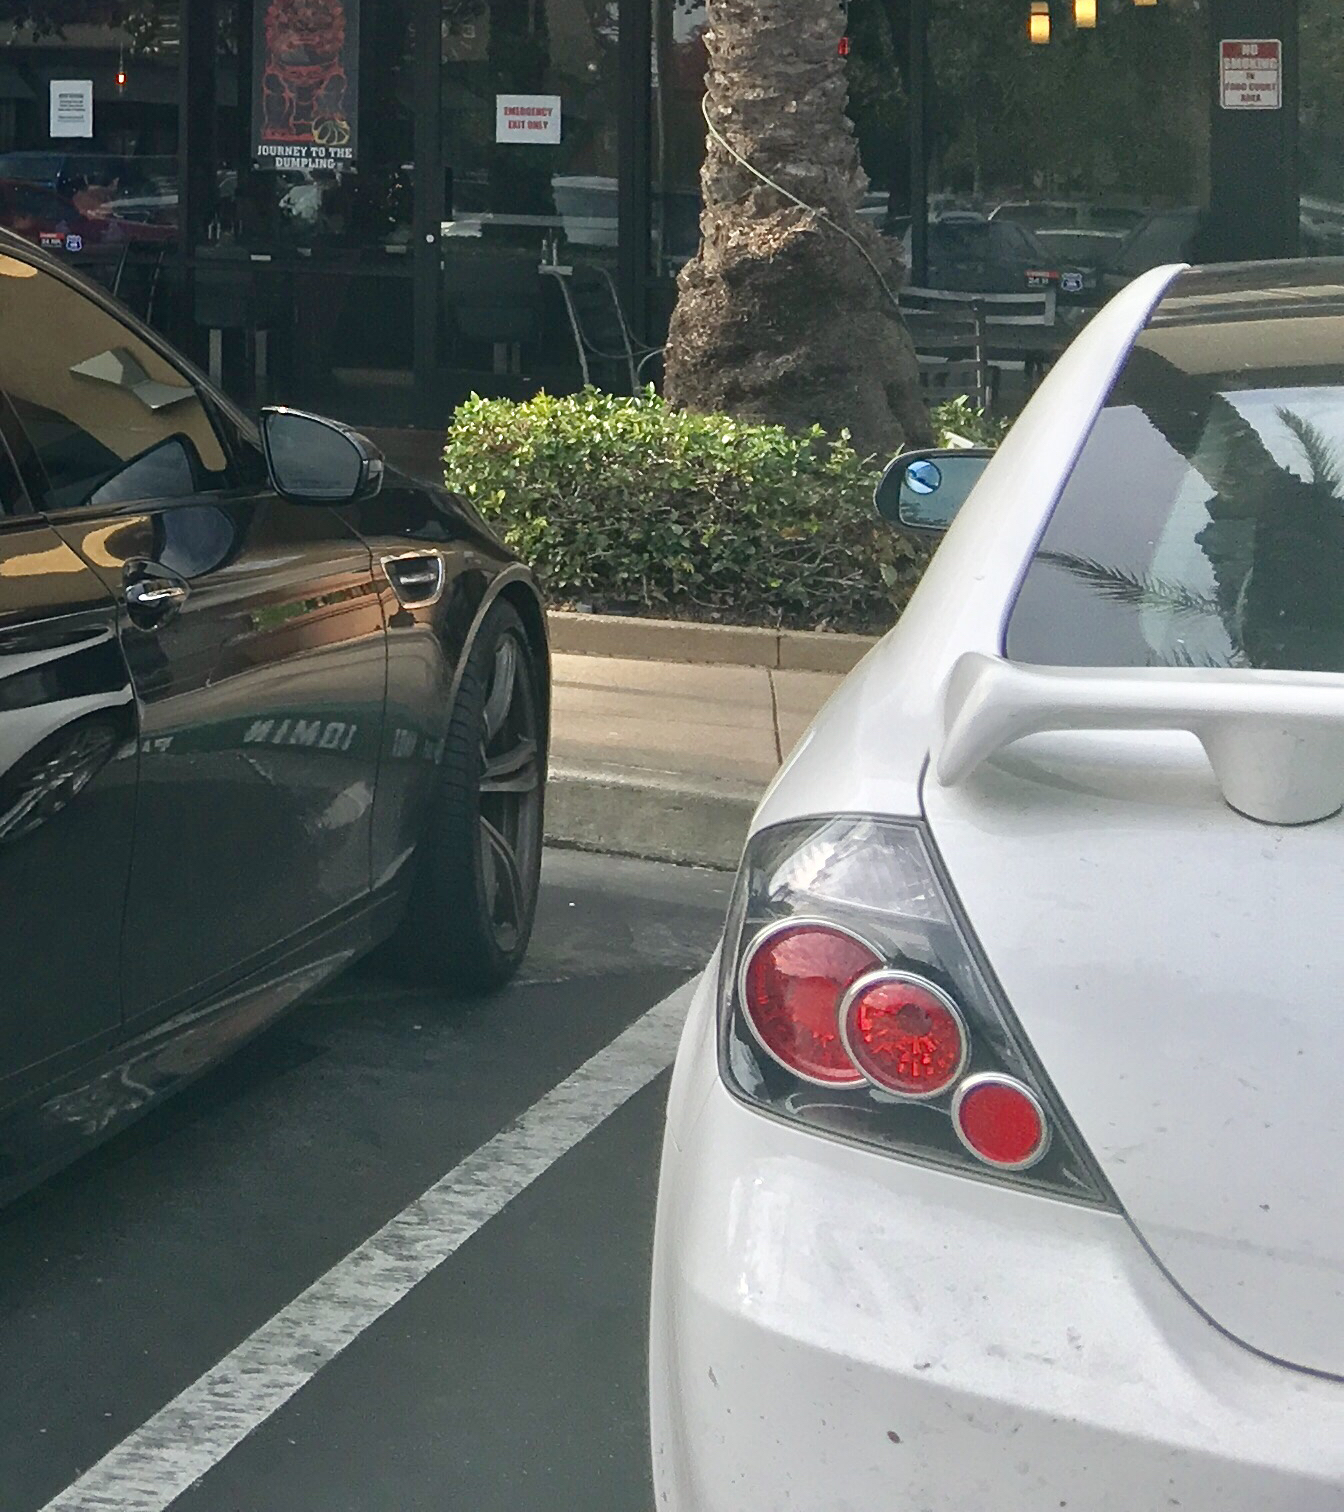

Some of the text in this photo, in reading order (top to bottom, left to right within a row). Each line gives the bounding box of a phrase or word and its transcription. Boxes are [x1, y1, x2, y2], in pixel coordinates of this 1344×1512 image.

[1242, 44, 1258, 56] NO
[257, 145, 353, 158] JOURNEY TO THE
[275, 157, 336, 169] DUMPLING
